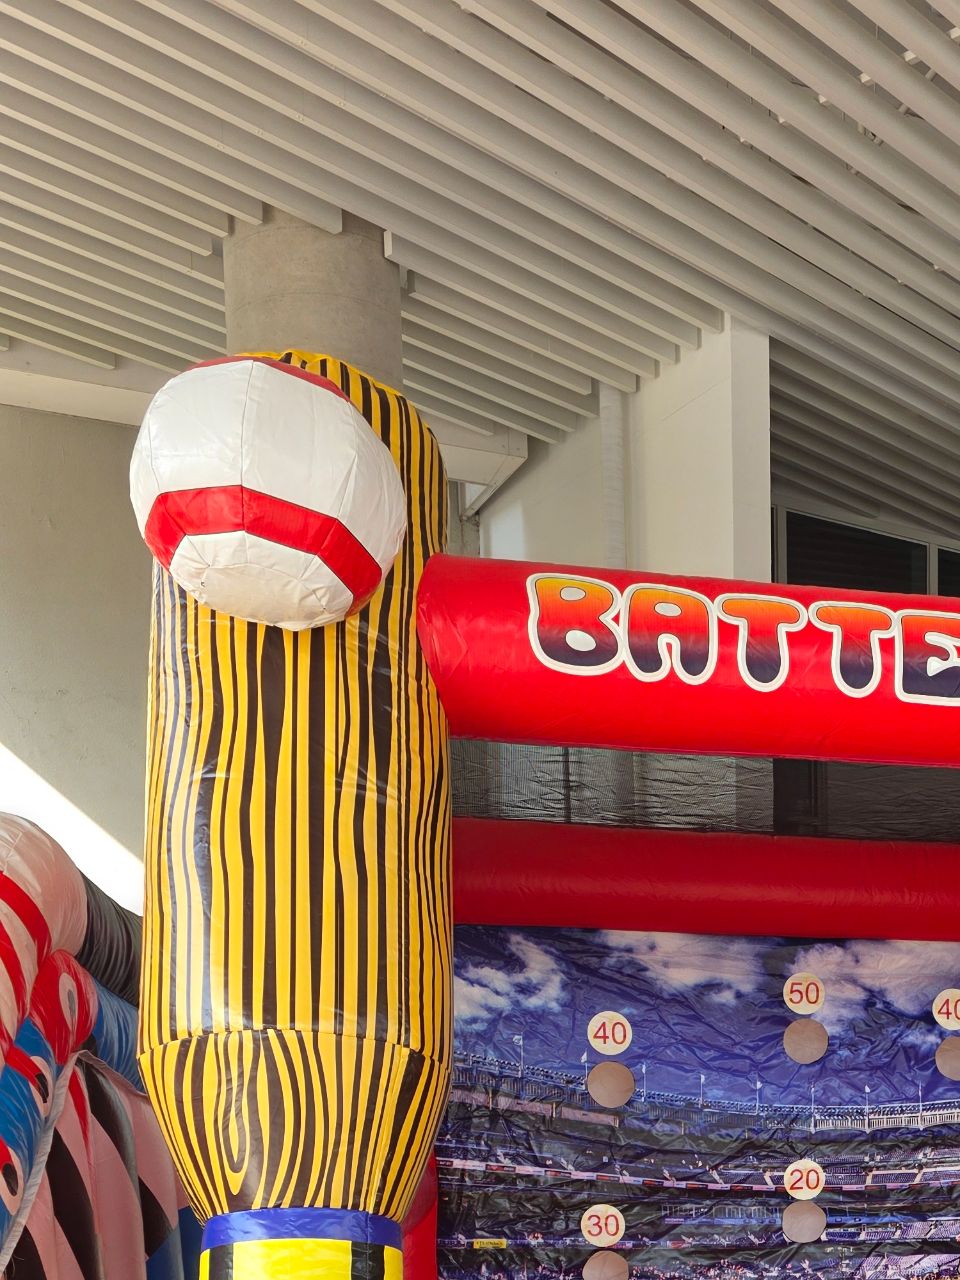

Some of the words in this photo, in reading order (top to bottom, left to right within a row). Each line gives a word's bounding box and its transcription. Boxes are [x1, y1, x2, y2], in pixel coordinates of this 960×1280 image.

[788, 981, 820, 1005] 50
[592, 1021, 628, 1045] 40
[789, 1168, 820, 1191] 20
[586, 1214, 620, 1237] 30
